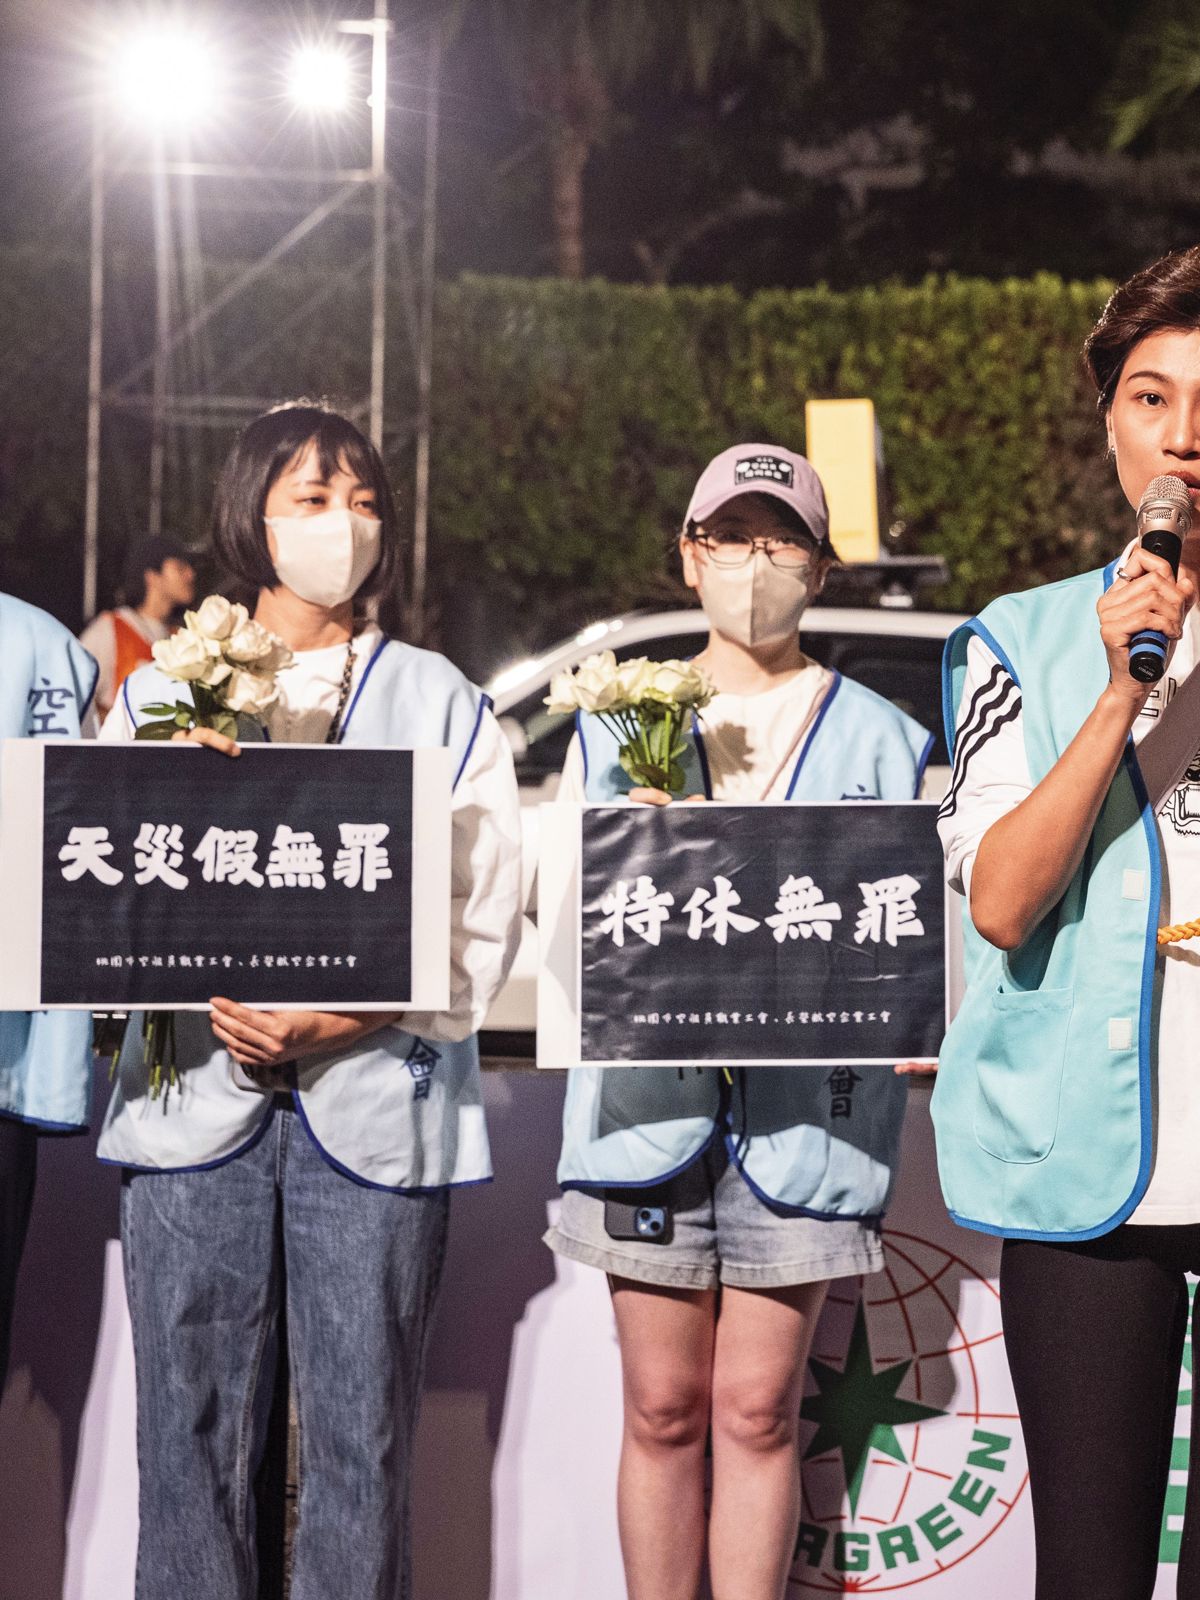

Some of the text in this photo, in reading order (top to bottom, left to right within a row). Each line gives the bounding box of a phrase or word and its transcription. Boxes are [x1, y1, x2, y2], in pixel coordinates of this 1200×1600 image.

[58, 822, 393, 892] 天災假無罪
[600, 874, 925, 947] 特休無罪
